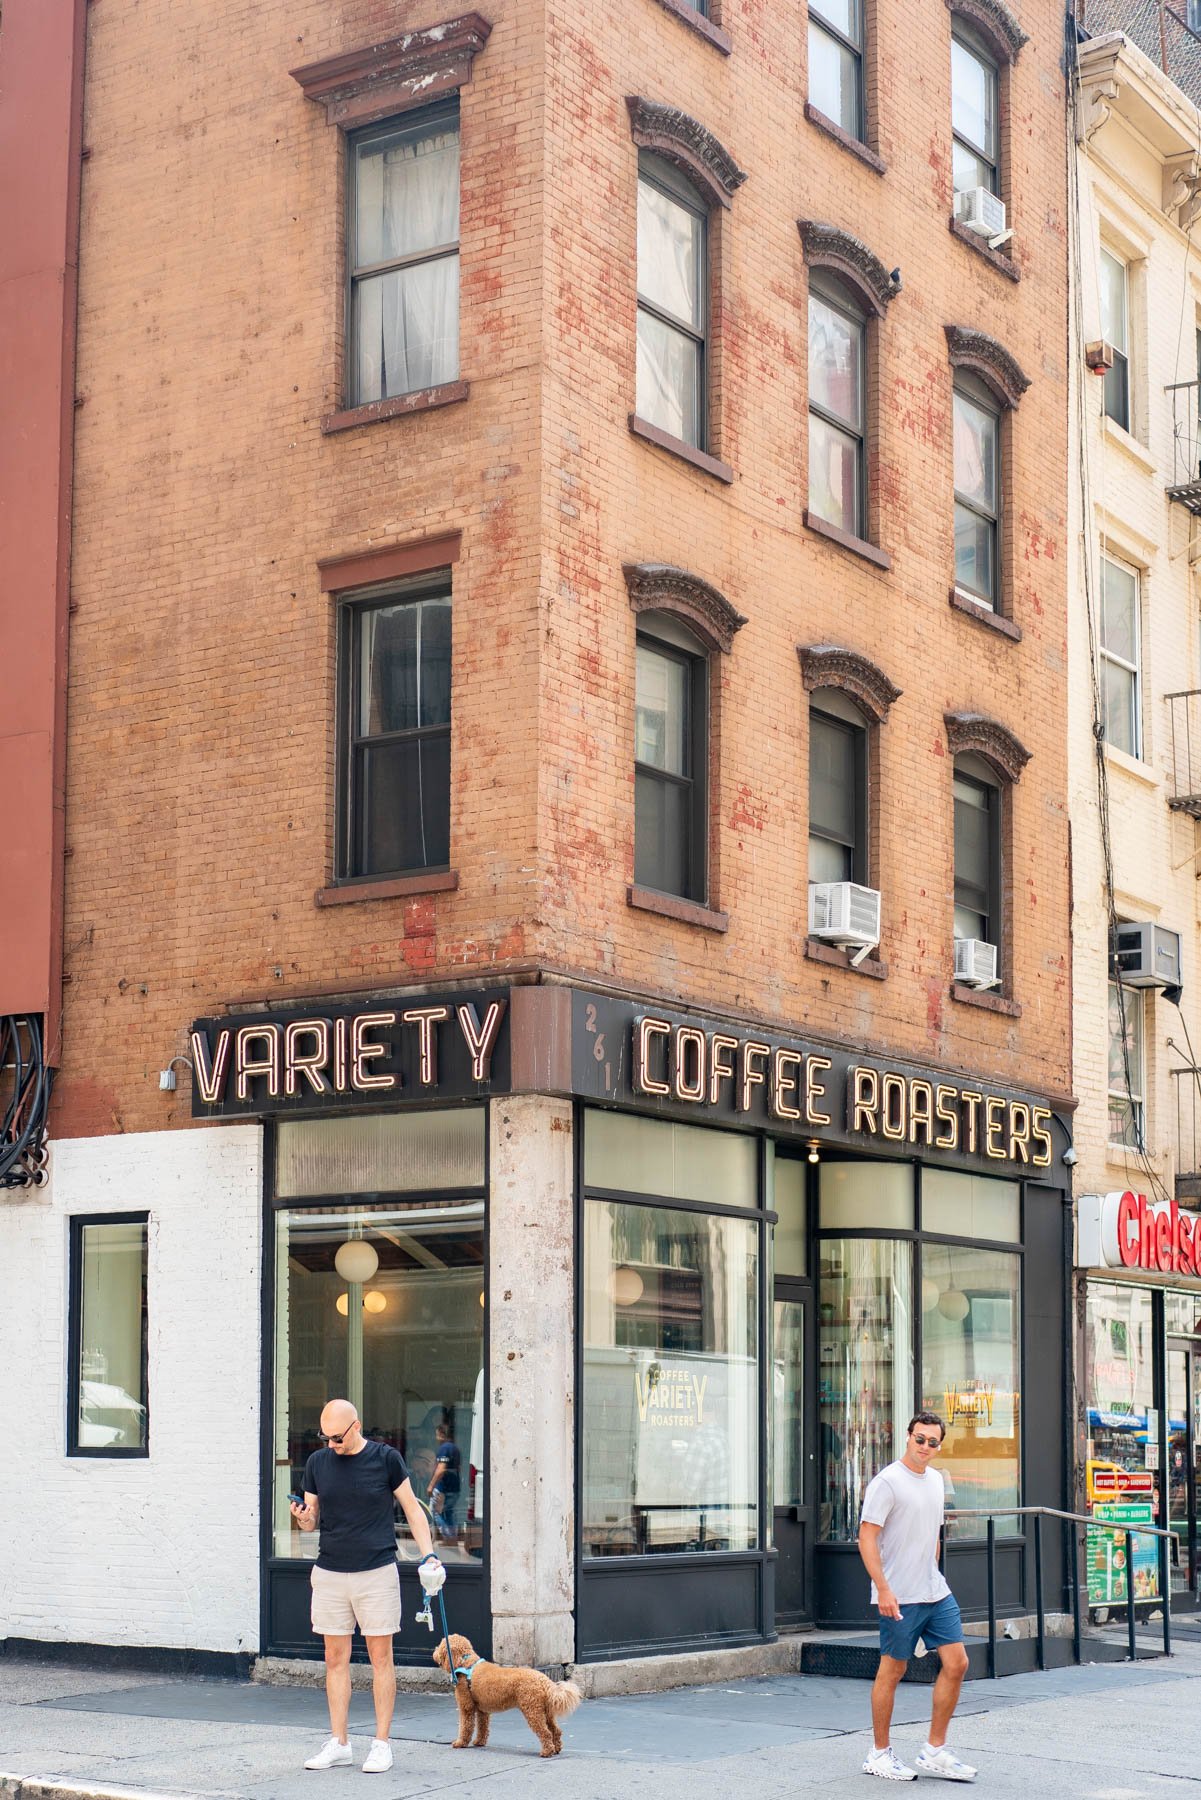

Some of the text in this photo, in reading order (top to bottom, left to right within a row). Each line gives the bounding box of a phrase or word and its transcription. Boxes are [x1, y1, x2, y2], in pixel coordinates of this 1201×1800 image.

[191, 1000, 506, 1102] VARIETY
[632, 1015, 1053, 1168] COFFEE ROASTERS
[635, 1372, 707, 1423] VARIETY
[653, 1370, 689, 1381] COFFEE
[651, 1415, 694, 1427] ROASTERS
[945, 1383, 995, 1425] VARIETY
